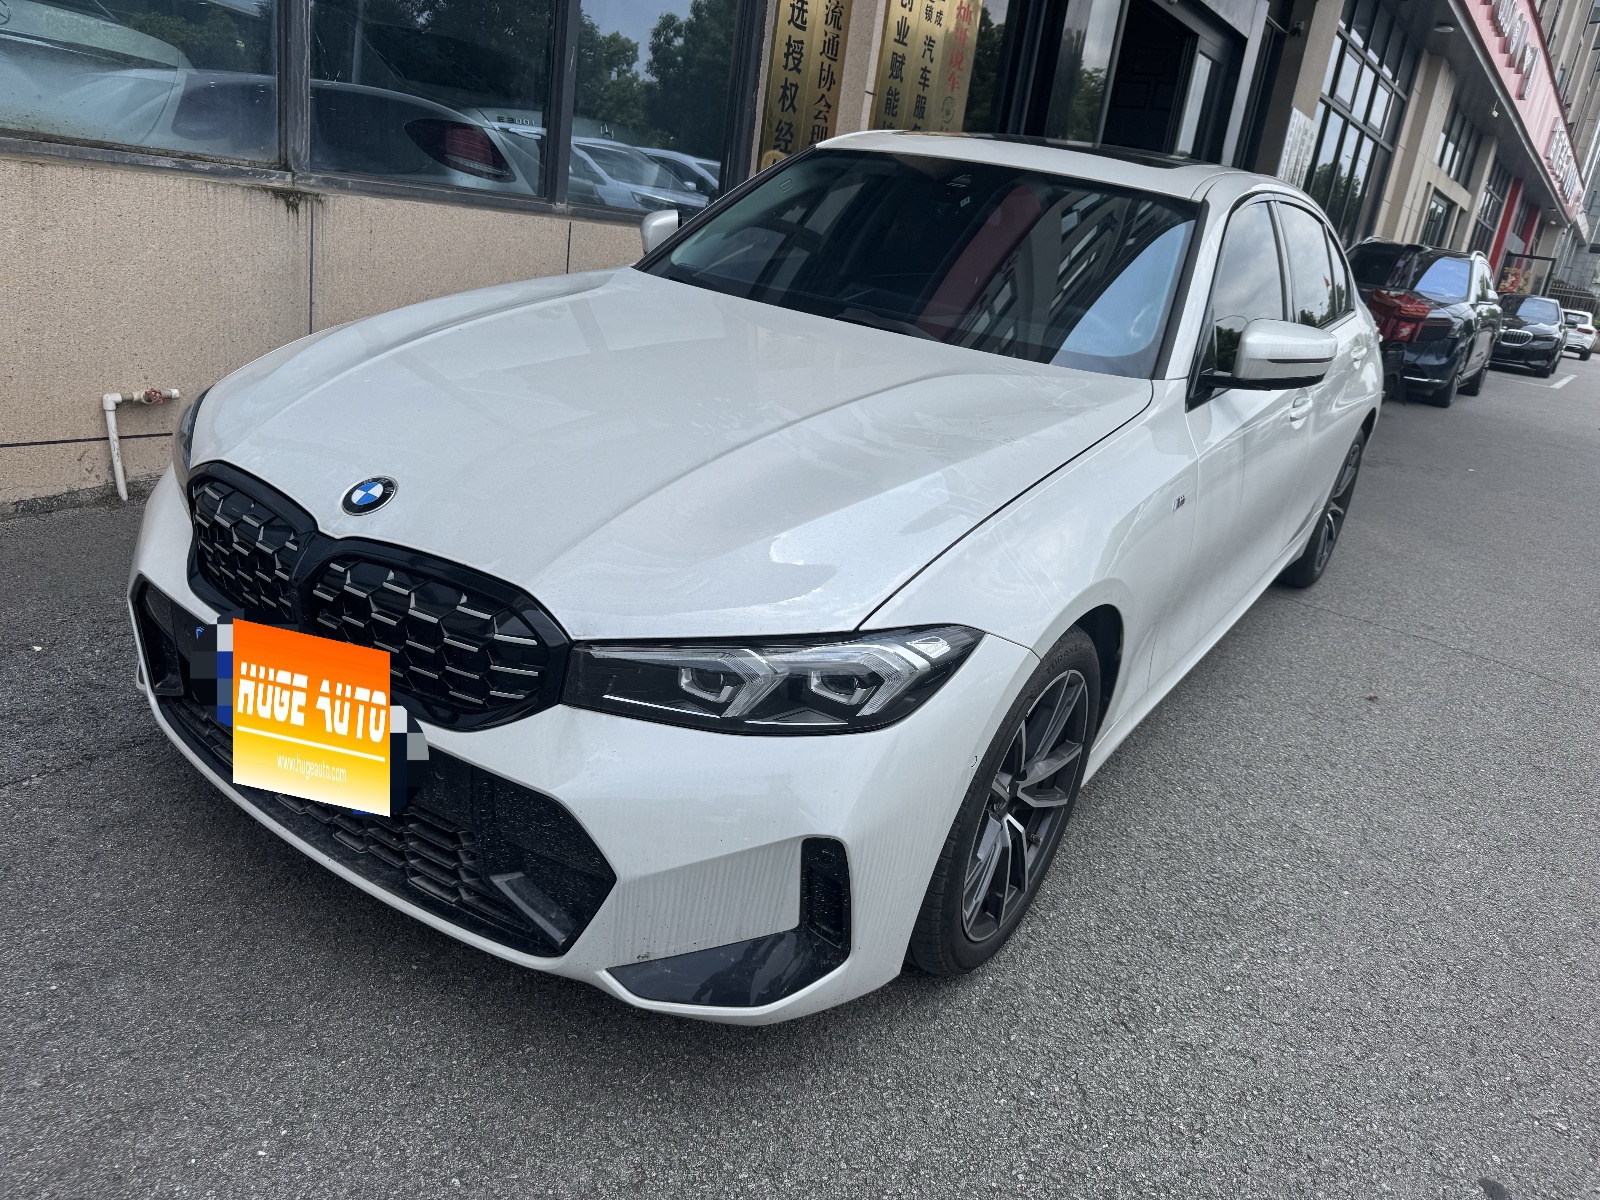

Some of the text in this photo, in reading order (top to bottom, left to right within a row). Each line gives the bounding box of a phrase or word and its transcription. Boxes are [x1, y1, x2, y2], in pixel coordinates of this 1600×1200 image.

[772, 0, 808, 163] 选授权经
[883, 0, 914, 130] 业赋能
